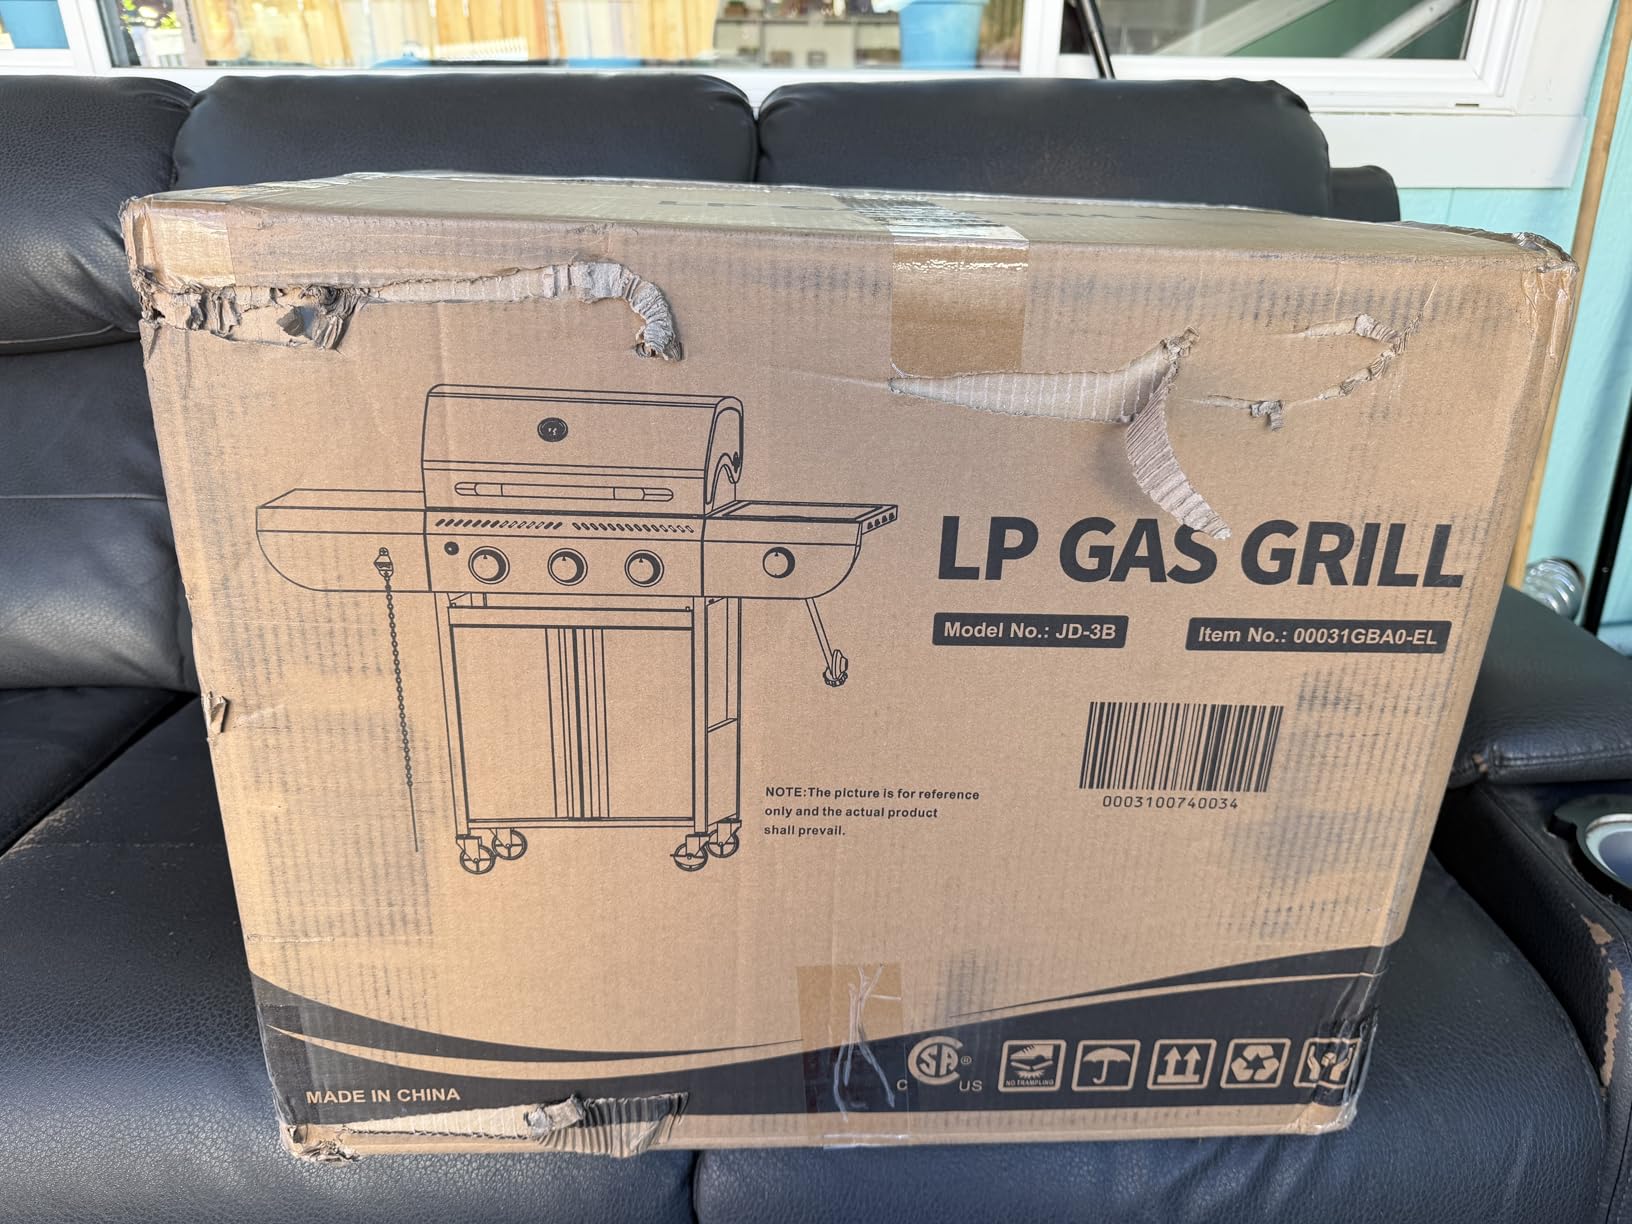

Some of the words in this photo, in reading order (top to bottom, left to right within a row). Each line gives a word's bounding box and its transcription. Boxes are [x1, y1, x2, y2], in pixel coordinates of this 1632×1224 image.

[938, 515, 1039, 581] LP
[1059, 516, 1219, 585] GAS
[1241, 519, 1465, 588] GRILL
[943, 621, 1004, 638] Model
[1009, 622, 1050, 639] No.:
[1055, 623, 1117, 641] JD-3B
[1198, 626, 1241, 643] Item
[1247, 627, 1288, 644] No.:
[1292, 627, 1438, 645] 00031GBA0-EL
[834, 787, 880, 799] picture
[883, 788, 894, 799] is
[897, 788, 916, 799] for
[918, 789, 980, 800] reference
[1102, 795, 1239, 810] 0003100740034
[764, 806, 793, 819] only
[795, 806, 819, 817] and
[822, 806, 842, 817] the
[845, 807, 885, 818] actual
[887, 807, 938, 820] product
[763, 825, 795, 836] shall
[798, 825, 847, 838] prevail.
[958, 1079, 983, 1092] US
[305, 1090, 365, 1104] MADE
[371, 1089, 391, 1103] IN
[397, 1087, 461, 1102] CHINA
